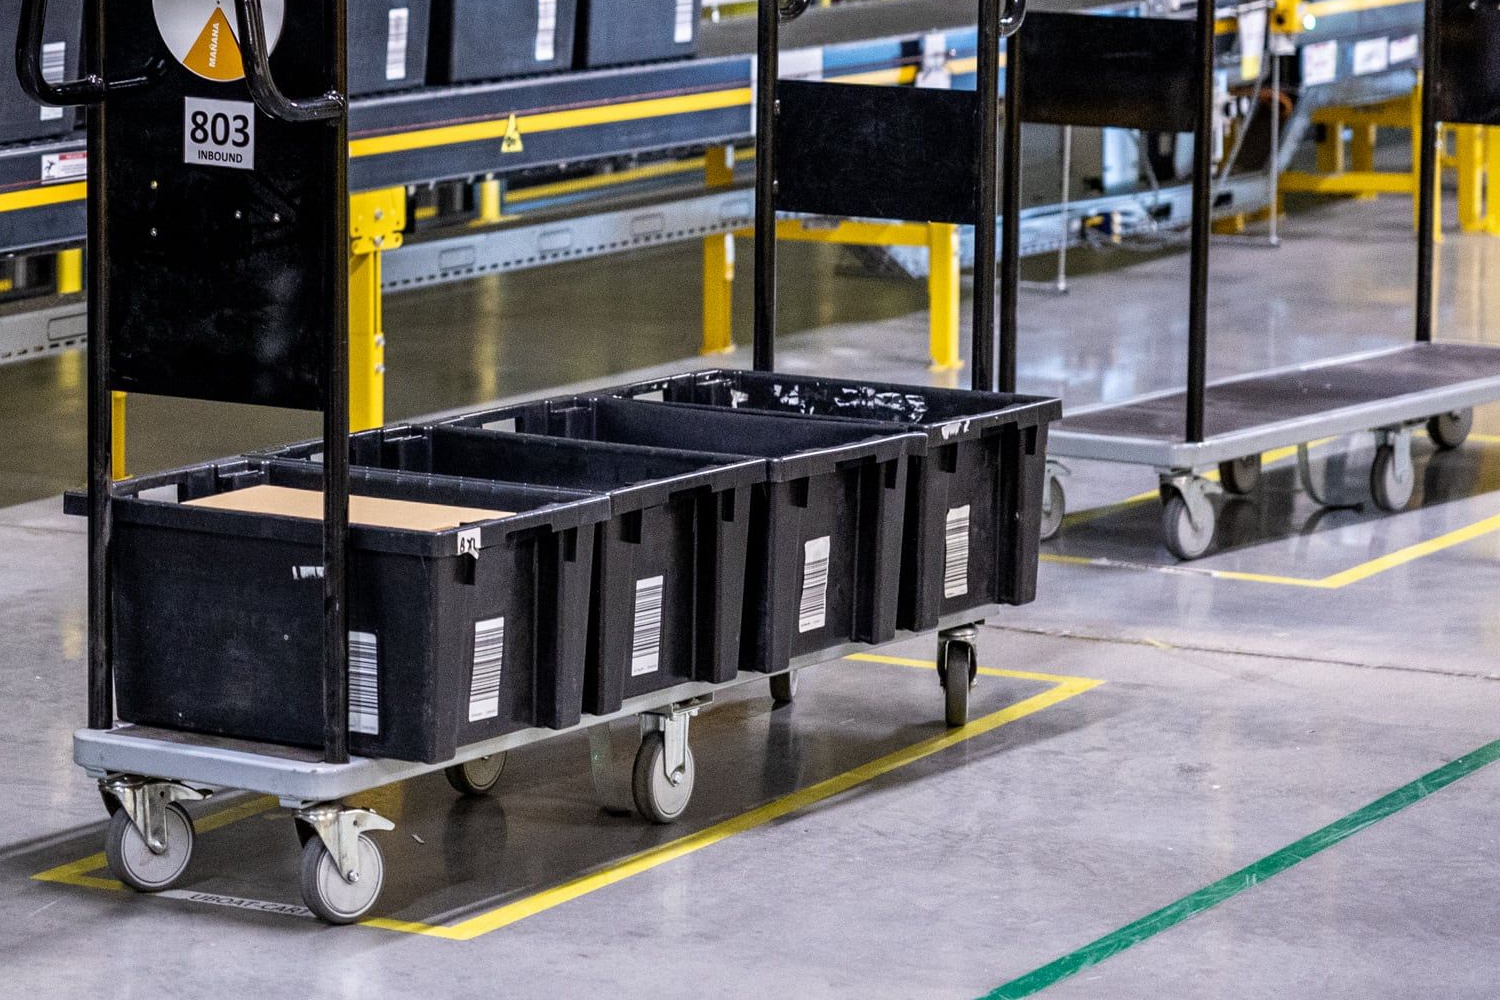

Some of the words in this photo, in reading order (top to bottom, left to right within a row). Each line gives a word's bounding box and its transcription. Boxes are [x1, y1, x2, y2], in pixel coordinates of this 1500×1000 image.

[208, 22, 220, 68] MAÑANA
[190, 110, 250, 148] 803
[197, 149, 243, 164] INBOUND
